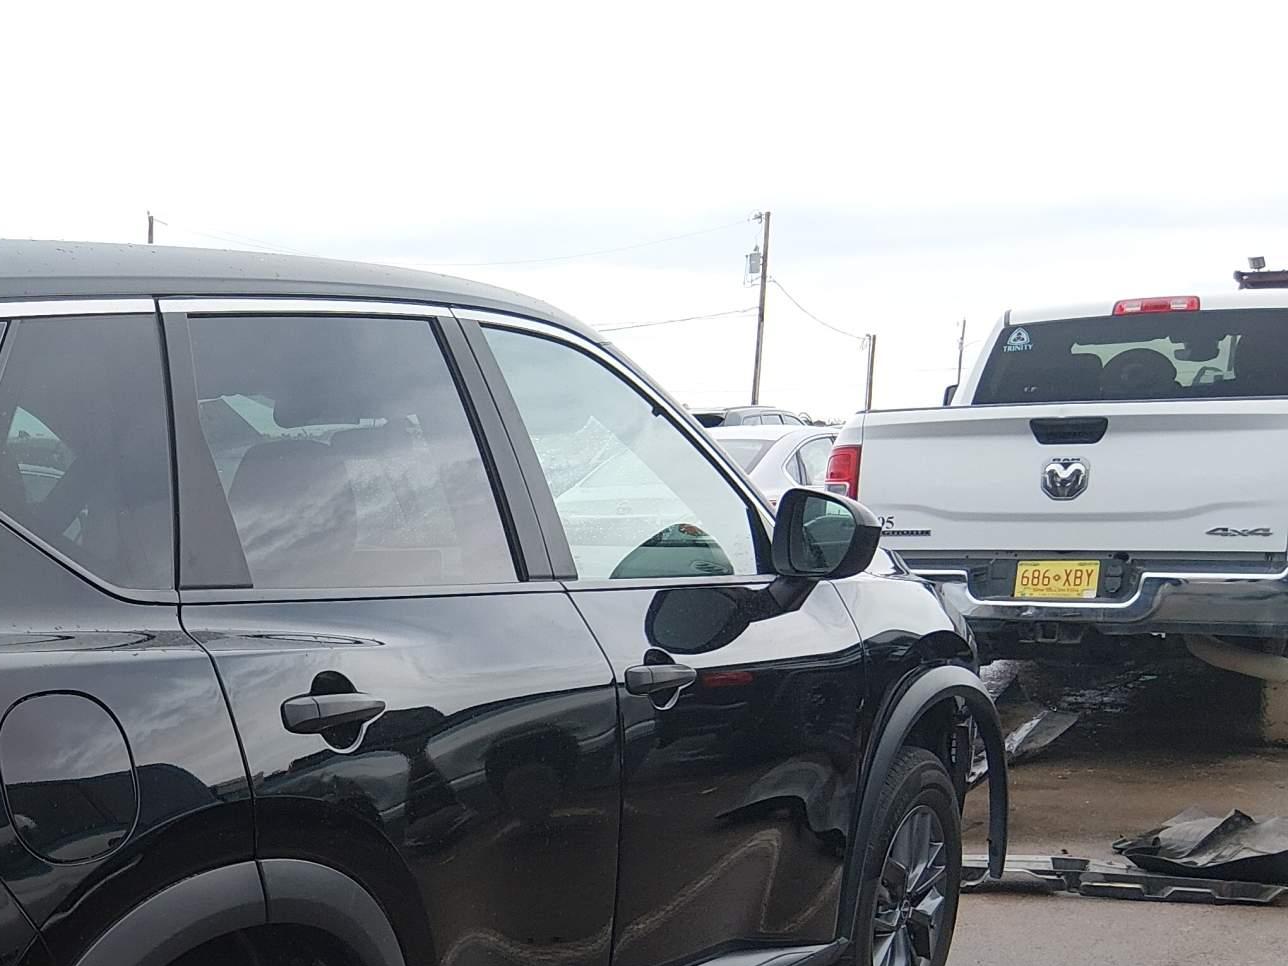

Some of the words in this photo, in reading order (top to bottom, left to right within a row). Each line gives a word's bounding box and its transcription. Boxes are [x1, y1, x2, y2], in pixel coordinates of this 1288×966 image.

[1003, 344, 1033, 352] TRINITY
[1206, 527, 1273, 537] 4x4
[1021, 569, 1050, 586] 686
[1063, 569, 1093, 586] XBY
